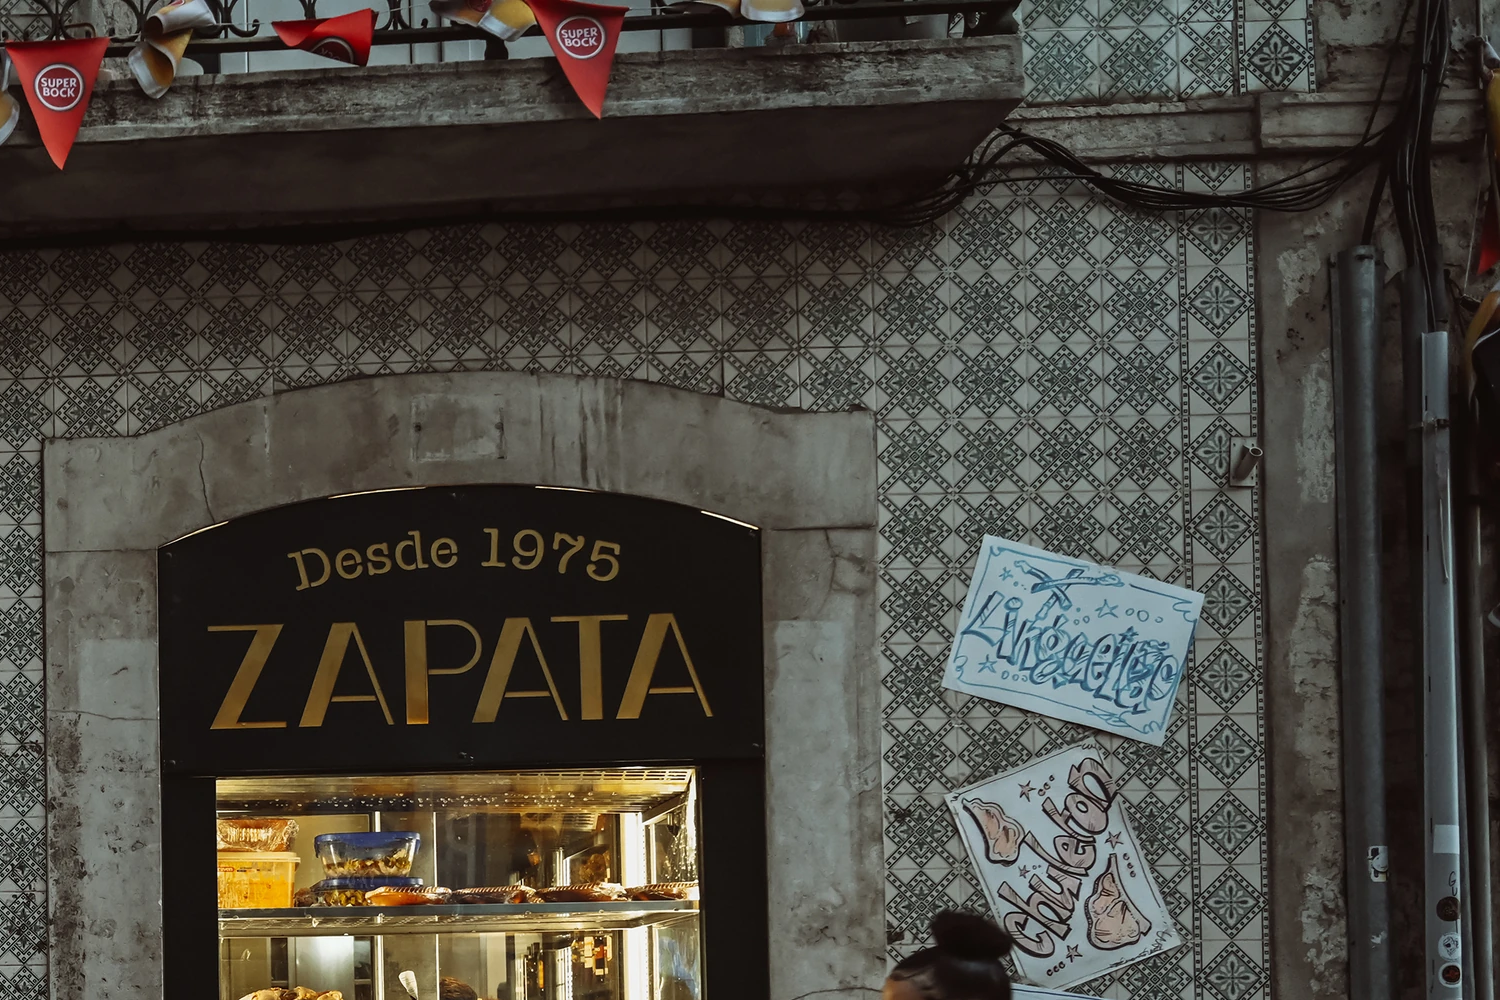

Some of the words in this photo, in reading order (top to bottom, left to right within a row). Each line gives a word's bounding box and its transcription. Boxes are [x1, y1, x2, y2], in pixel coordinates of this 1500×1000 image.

[561, 27, 598, 39] SUPER
[564, 37, 598, 47] BOCK
[41, 77, 77, 88] SUPER
[42, 87, 75, 98] BOCK
[287, 530, 458, 591] Desde
[481, 527, 622, 581] 1975
[207, 613, 714, 729] ZAPATA
